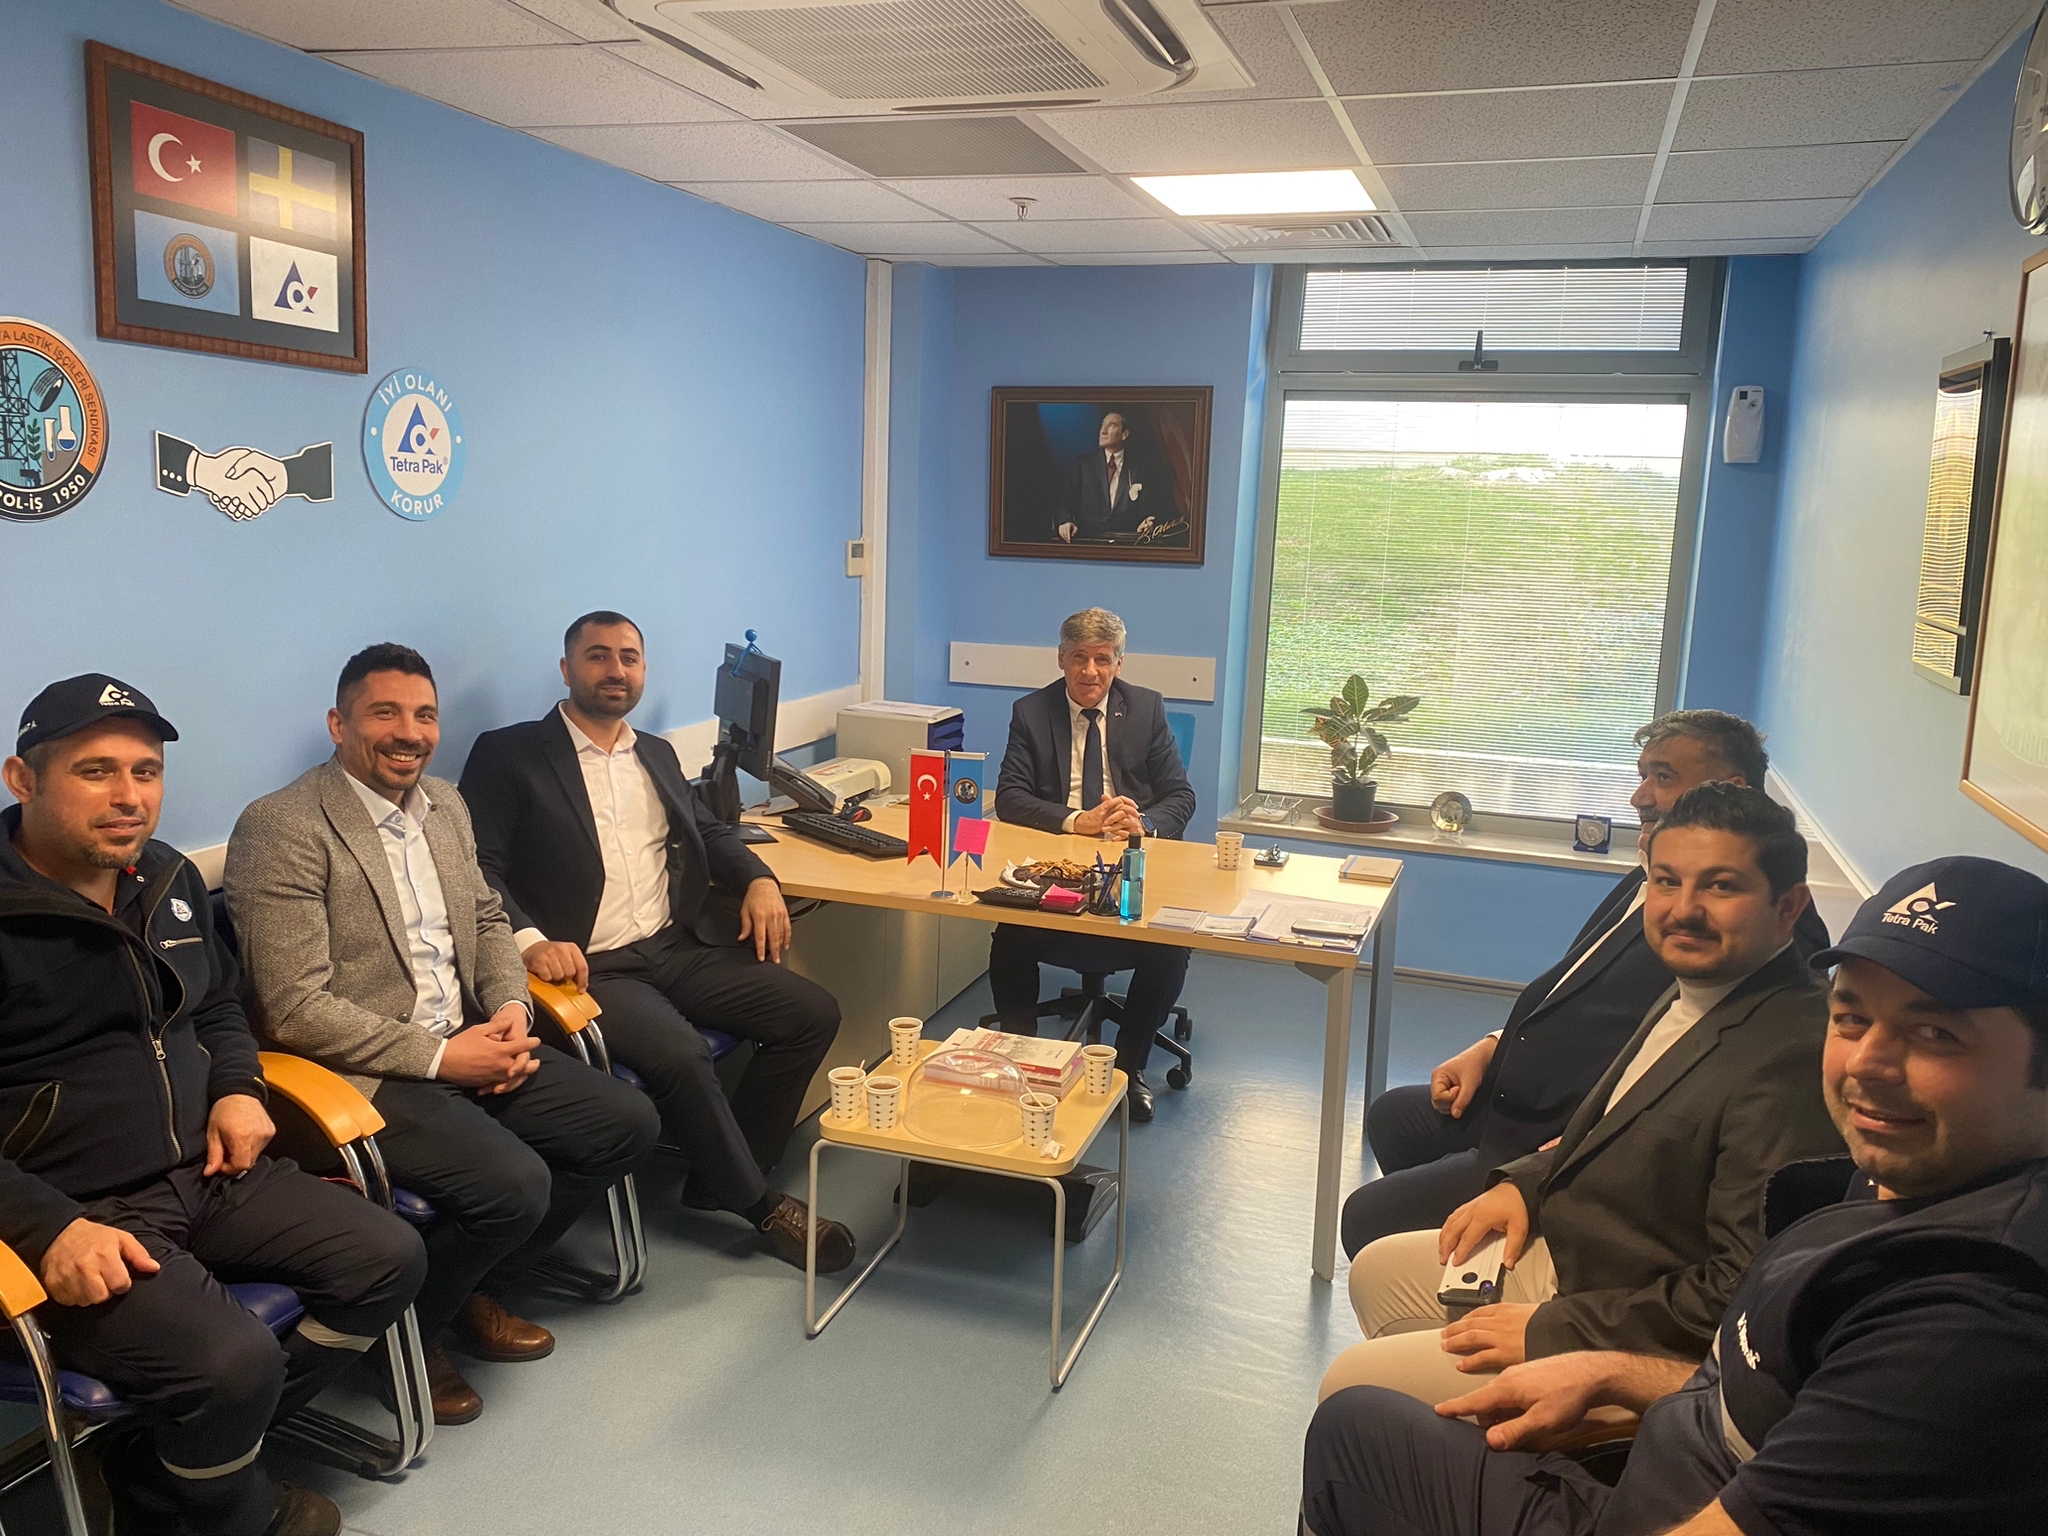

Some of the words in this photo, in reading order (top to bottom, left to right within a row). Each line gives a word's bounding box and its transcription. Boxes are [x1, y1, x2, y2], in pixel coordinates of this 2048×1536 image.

[14, 331, 52, 351] LASTİK
[85, 393, 100, 457] SENDİKASI
[378, 375, 401, 405] İYİ
[405, 374, 453, 412] OLANI
[390, 456, 420, 473] Tetra
[52, 474, 86, 504] 1950
[391, 490, 444, 515] KORUR
[1882, 912, 1911, 926] Tetra
[1912, 918, 1938, 934] Pak
